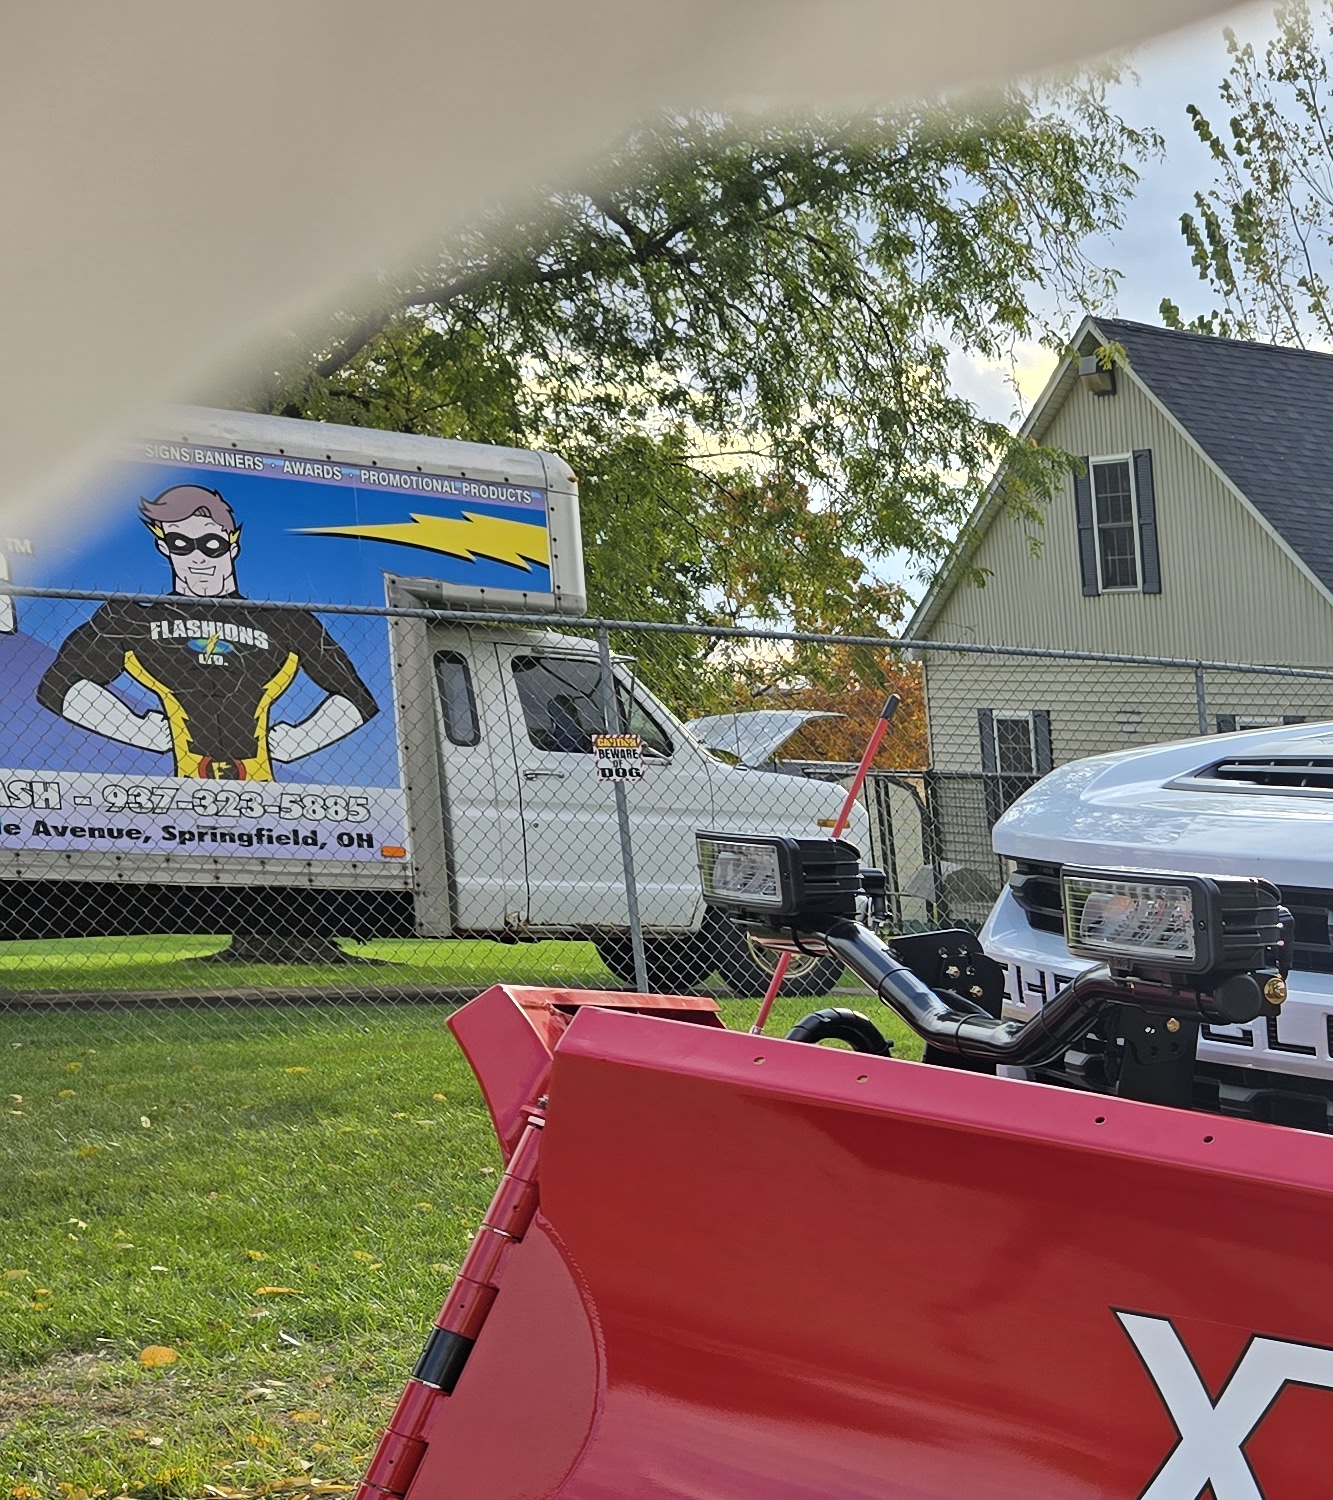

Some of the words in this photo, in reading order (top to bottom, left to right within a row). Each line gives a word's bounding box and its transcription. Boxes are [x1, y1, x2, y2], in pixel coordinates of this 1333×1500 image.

[283, 460, 343, 481] AWARDS
[360, 469, 459, 495] PROMOTIONAL
[462, 482, 532, 504] PRODUCTS
[150, 619, 269, 650] FLASHIONS
[198, 653, 229, 666] LTD.
[599, 748, 639, 759] BEWARE
[612, 759, 624, 768] OF
[600, 767, 642, 778] DOG
[102, 784, 371, 823] 937-323-5885
[0, 823, 21, 835] e
[32, 820, 152, 844] Avenue,
[161, 825, 327, 850] Springfield,
[336, 832, 374, 849] OH
